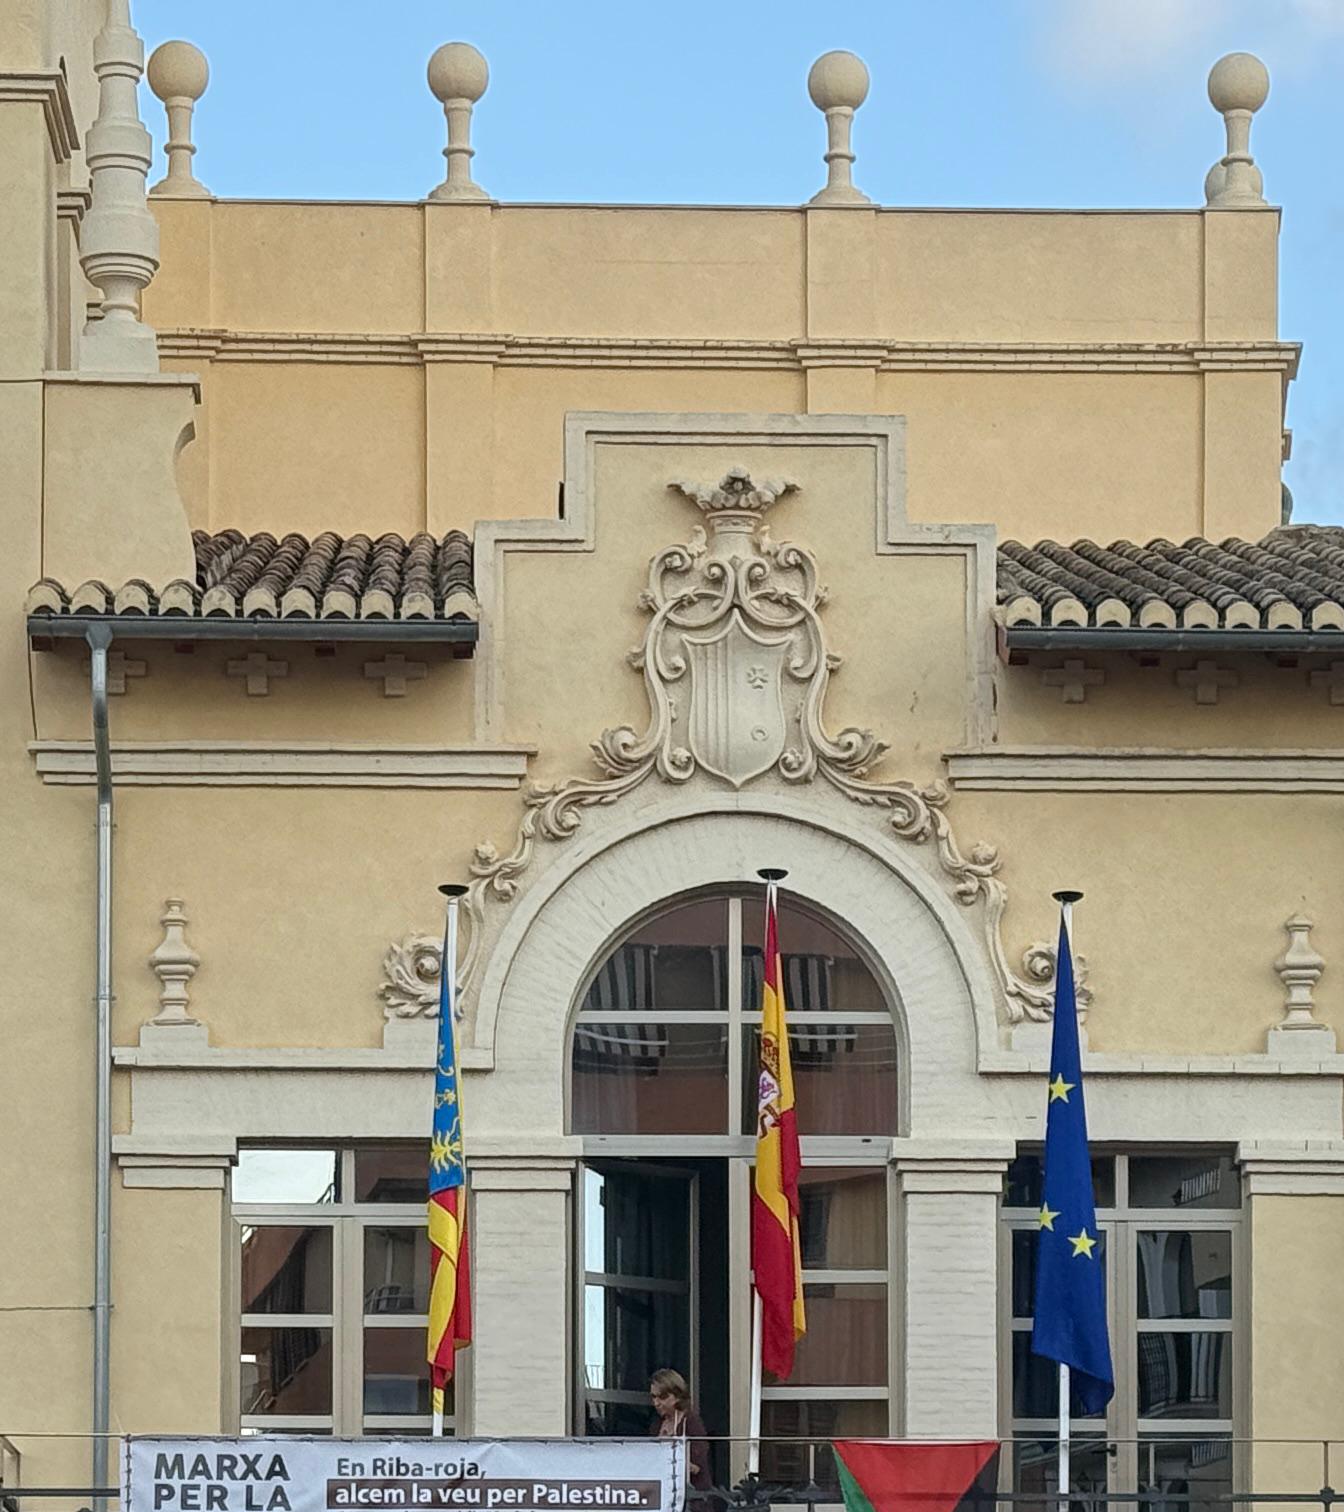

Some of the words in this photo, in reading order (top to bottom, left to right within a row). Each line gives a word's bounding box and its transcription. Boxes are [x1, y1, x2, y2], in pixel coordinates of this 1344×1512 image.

[154, 1453, 291, 1481] MARXA
[337, 1458, 365, 1477] En
[372, 1457, 487, 1482] Riba-roja,
[154, 1483, 228, 1511] PER
[245, 1485, 292, 1511] LA
[335, 1483, 406, 1504] alcem
[412, 1483, 432, 1504] la
[437, 1487, 481, 1504] veu
[487, 1487, 528, 1508] per
[532, 1483, 648, 1505] Palestina.
